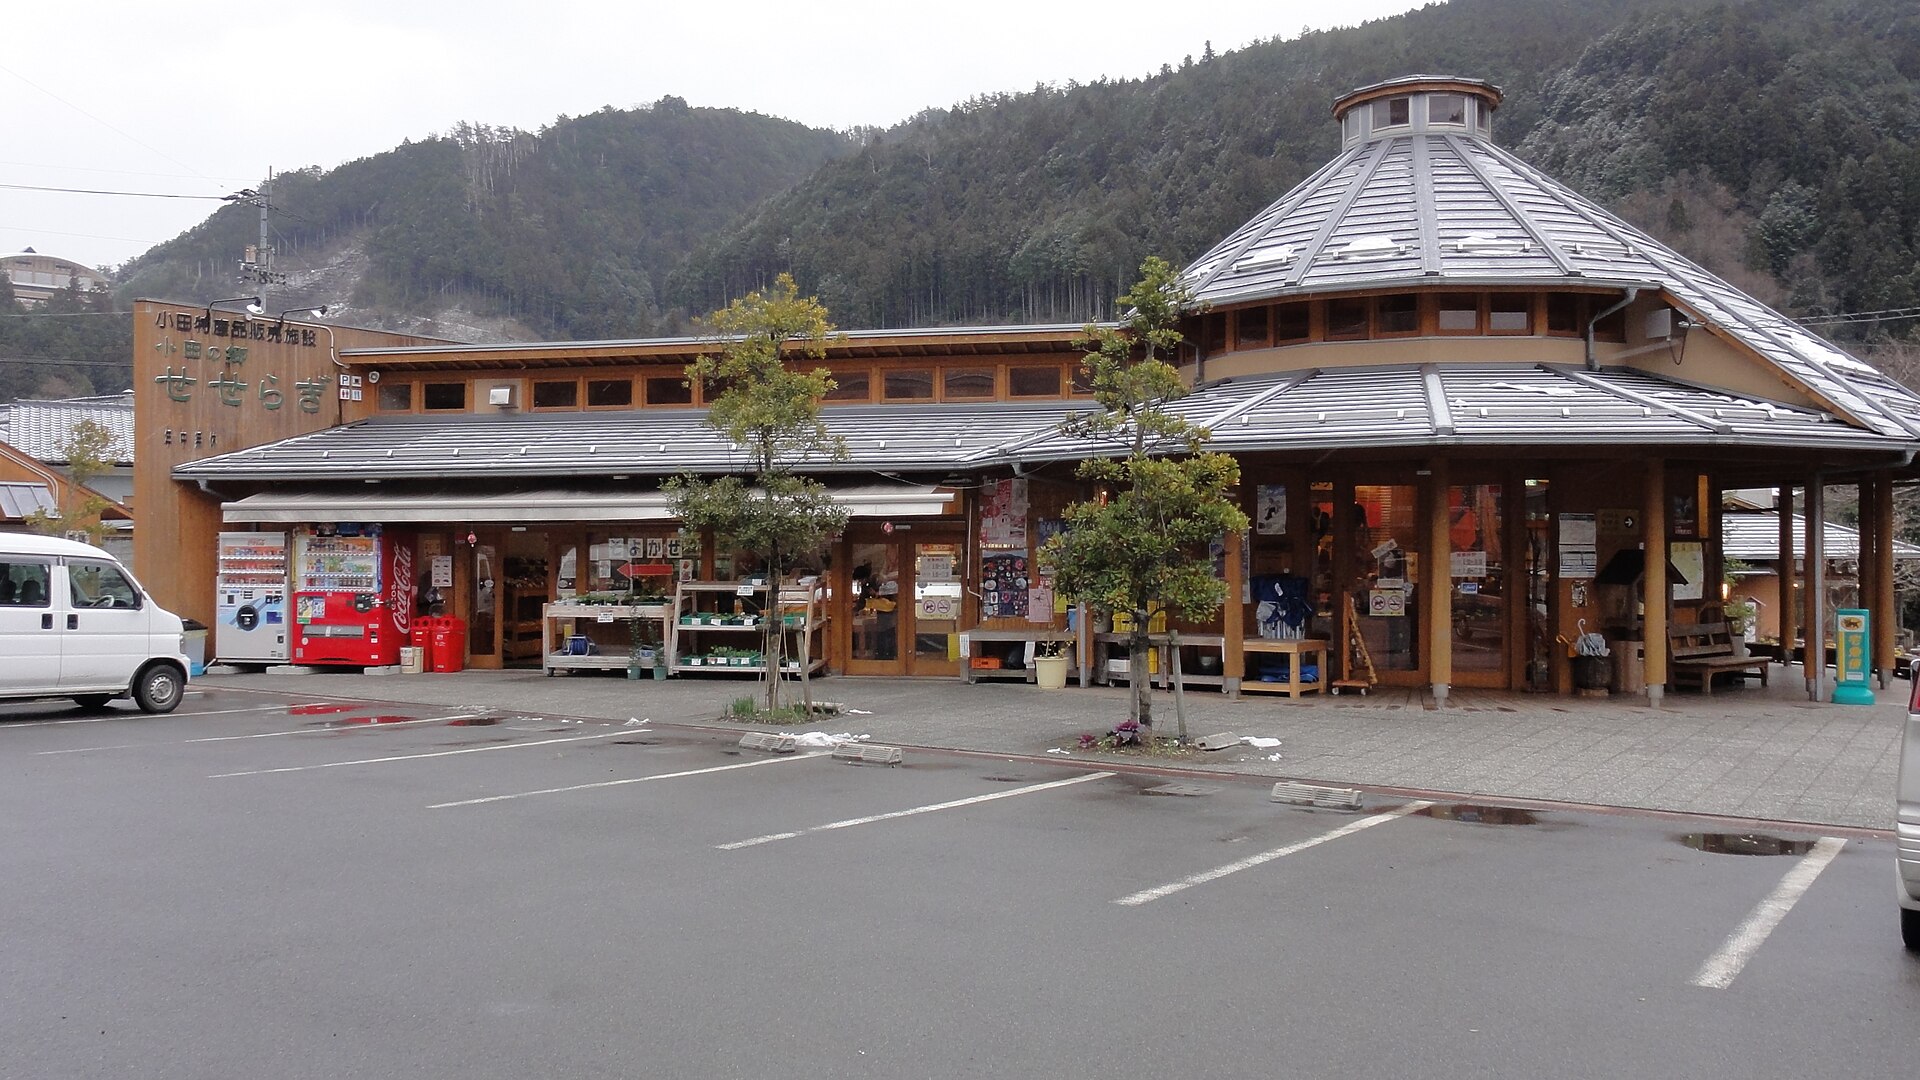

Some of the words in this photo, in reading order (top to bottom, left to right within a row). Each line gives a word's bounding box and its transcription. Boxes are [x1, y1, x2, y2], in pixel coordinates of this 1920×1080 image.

[156, 311, 317, 347] 小田特産品販売施設
[155, 336, 248, 365] 小田の郷
[155, 366, 332, 413] せせらぎ
